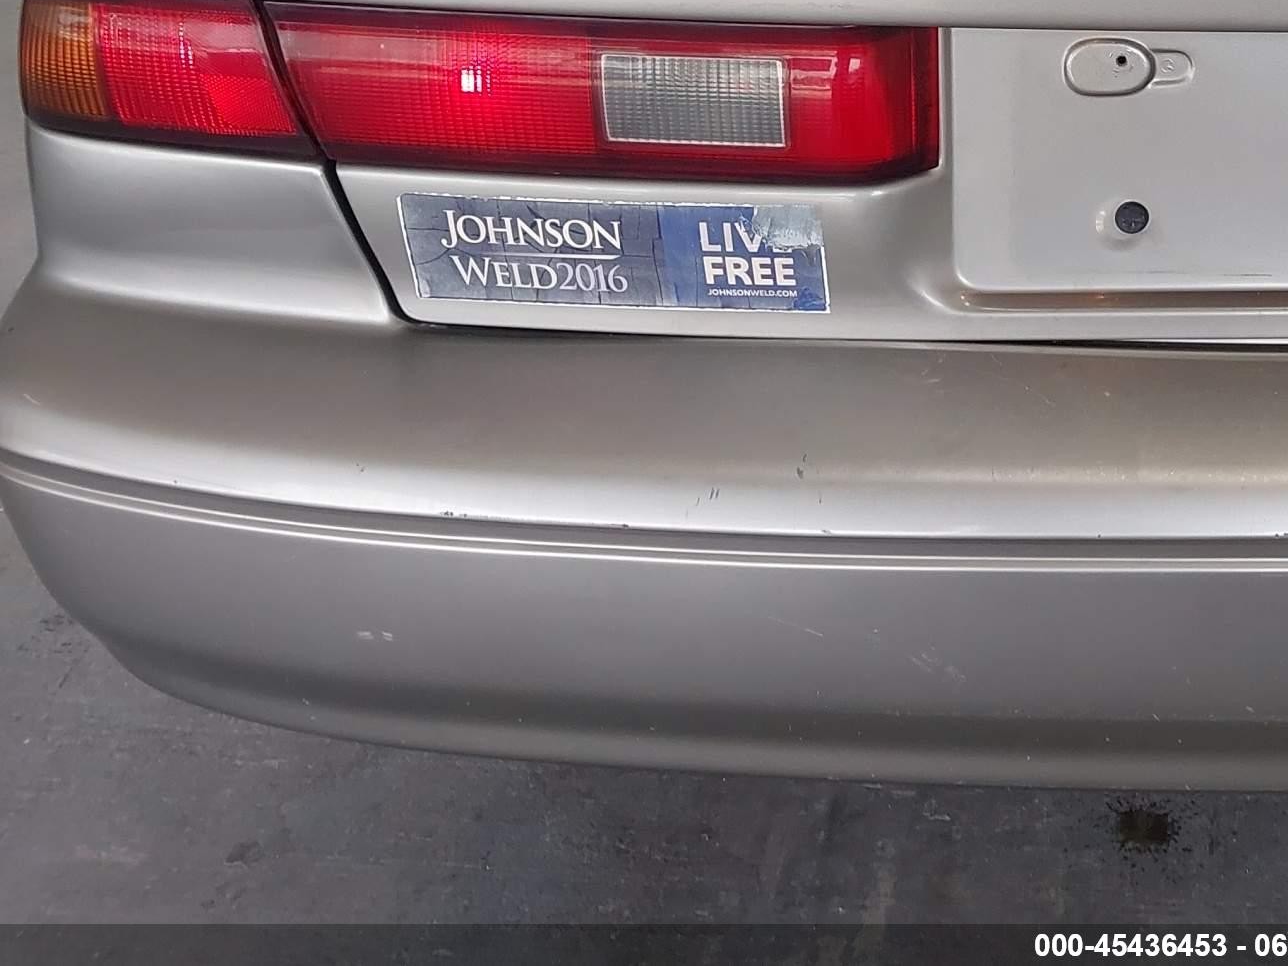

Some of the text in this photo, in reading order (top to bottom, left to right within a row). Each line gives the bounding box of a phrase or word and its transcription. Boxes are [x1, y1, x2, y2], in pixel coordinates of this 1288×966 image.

[440, 209, 622, 250] JOHNSON
[698, 221, 793, 253] LIV
[703, 256, 797, 286] FREE
[708, 288, 798, 298] JOHNSONWELD.COM
